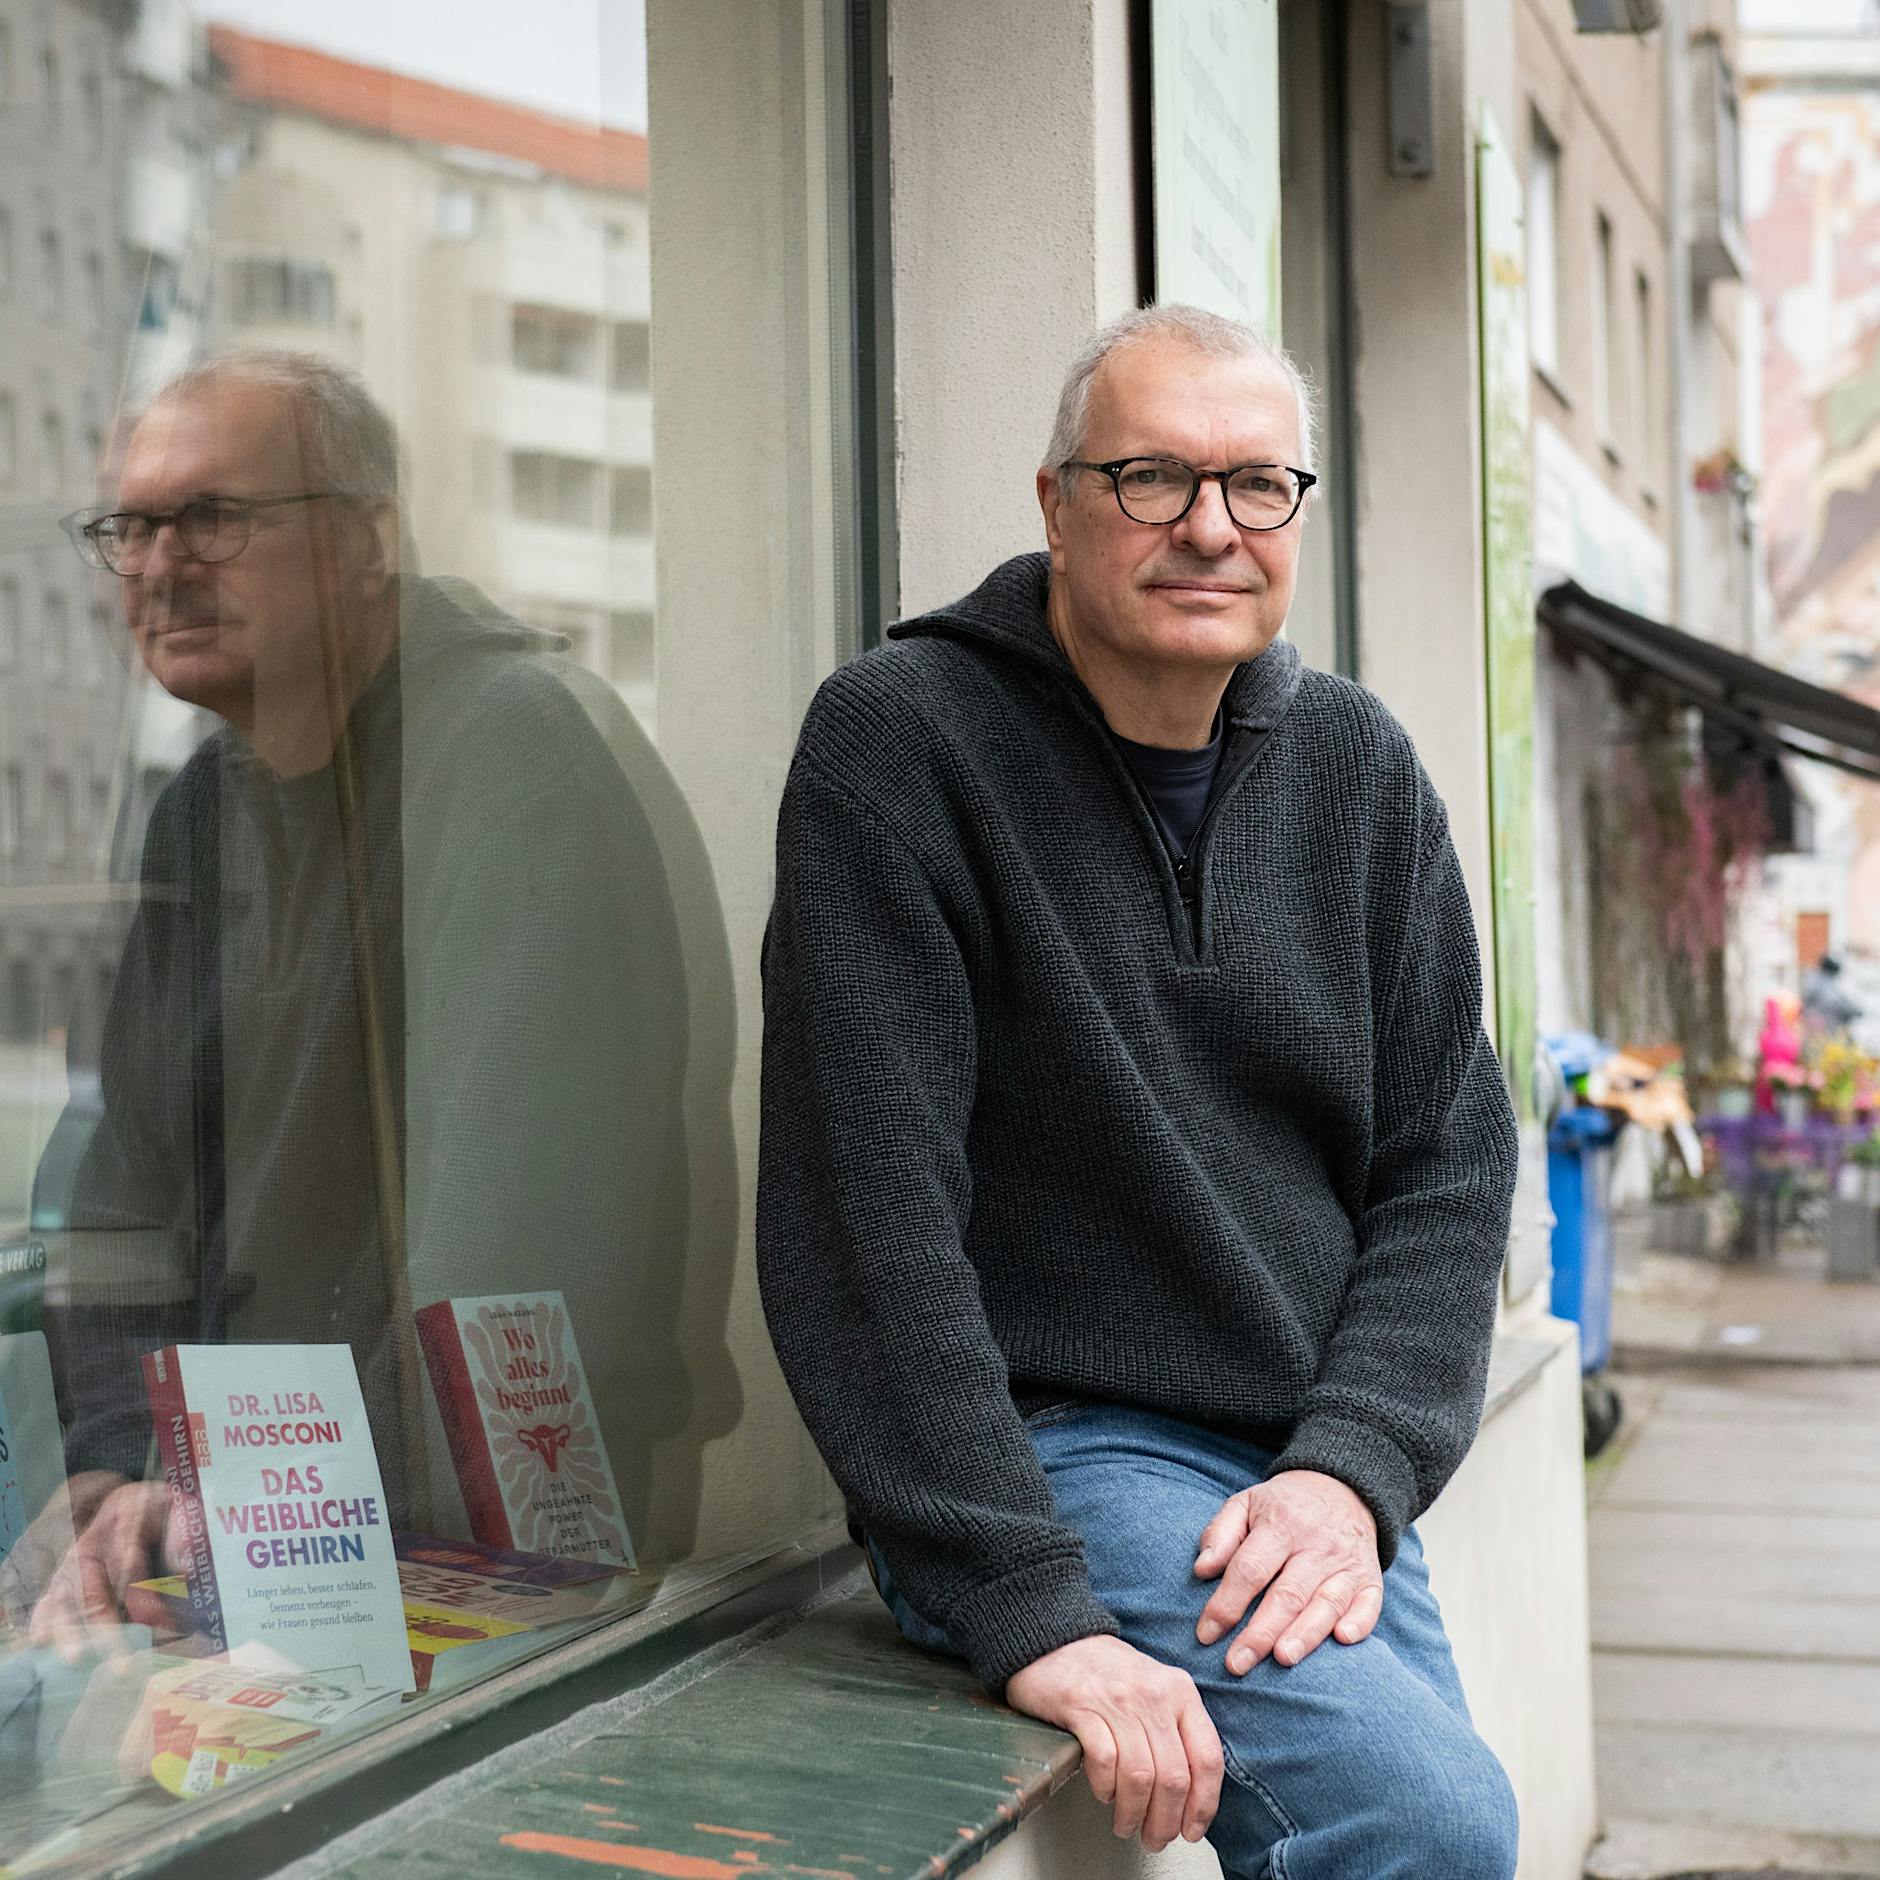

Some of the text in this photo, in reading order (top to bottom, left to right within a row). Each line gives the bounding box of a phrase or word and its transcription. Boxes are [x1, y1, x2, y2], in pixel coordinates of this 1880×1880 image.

[8, 1246, 44, 1273] VERLAG
[502, 1328, 535, 1351] Wo
[506, 1356, 549, 1380] alles
[227, 1392, 325, 1417] DR. LISA
[495, 1383, 573, 1416] beginnt
[224, 1421, 342, 1448] MOSCONI
[261, 1465, 324, 1496] DAS
[550, 1482, 567, 1493] DIE
[167, 1465, 190, 1541] MOSCONI
[532, 1494, 593, 1511] UNGEAHNTE
[216, 1497, 380, 1535] WEIBLICHE
[549, 1511, 585, 1524] POWER
[171, 1414, 224, 1652] DAS WEIBLICHE GEHIRN
[560, 1527, 580, 1538] DER
[246, 1533, 365, 1569] GEHIRN
[246, 1587, 278, 1600] Länger
[279, 1585, 307, 1596] leben,
[307, 1583, 335, 1594] besser
[269, 1602, 306, 1613] Demenz
[306, 1600, 352, 1611] vorbeugen
[260, 1611, 374, 1630] wie Frauen gesund bleiben
